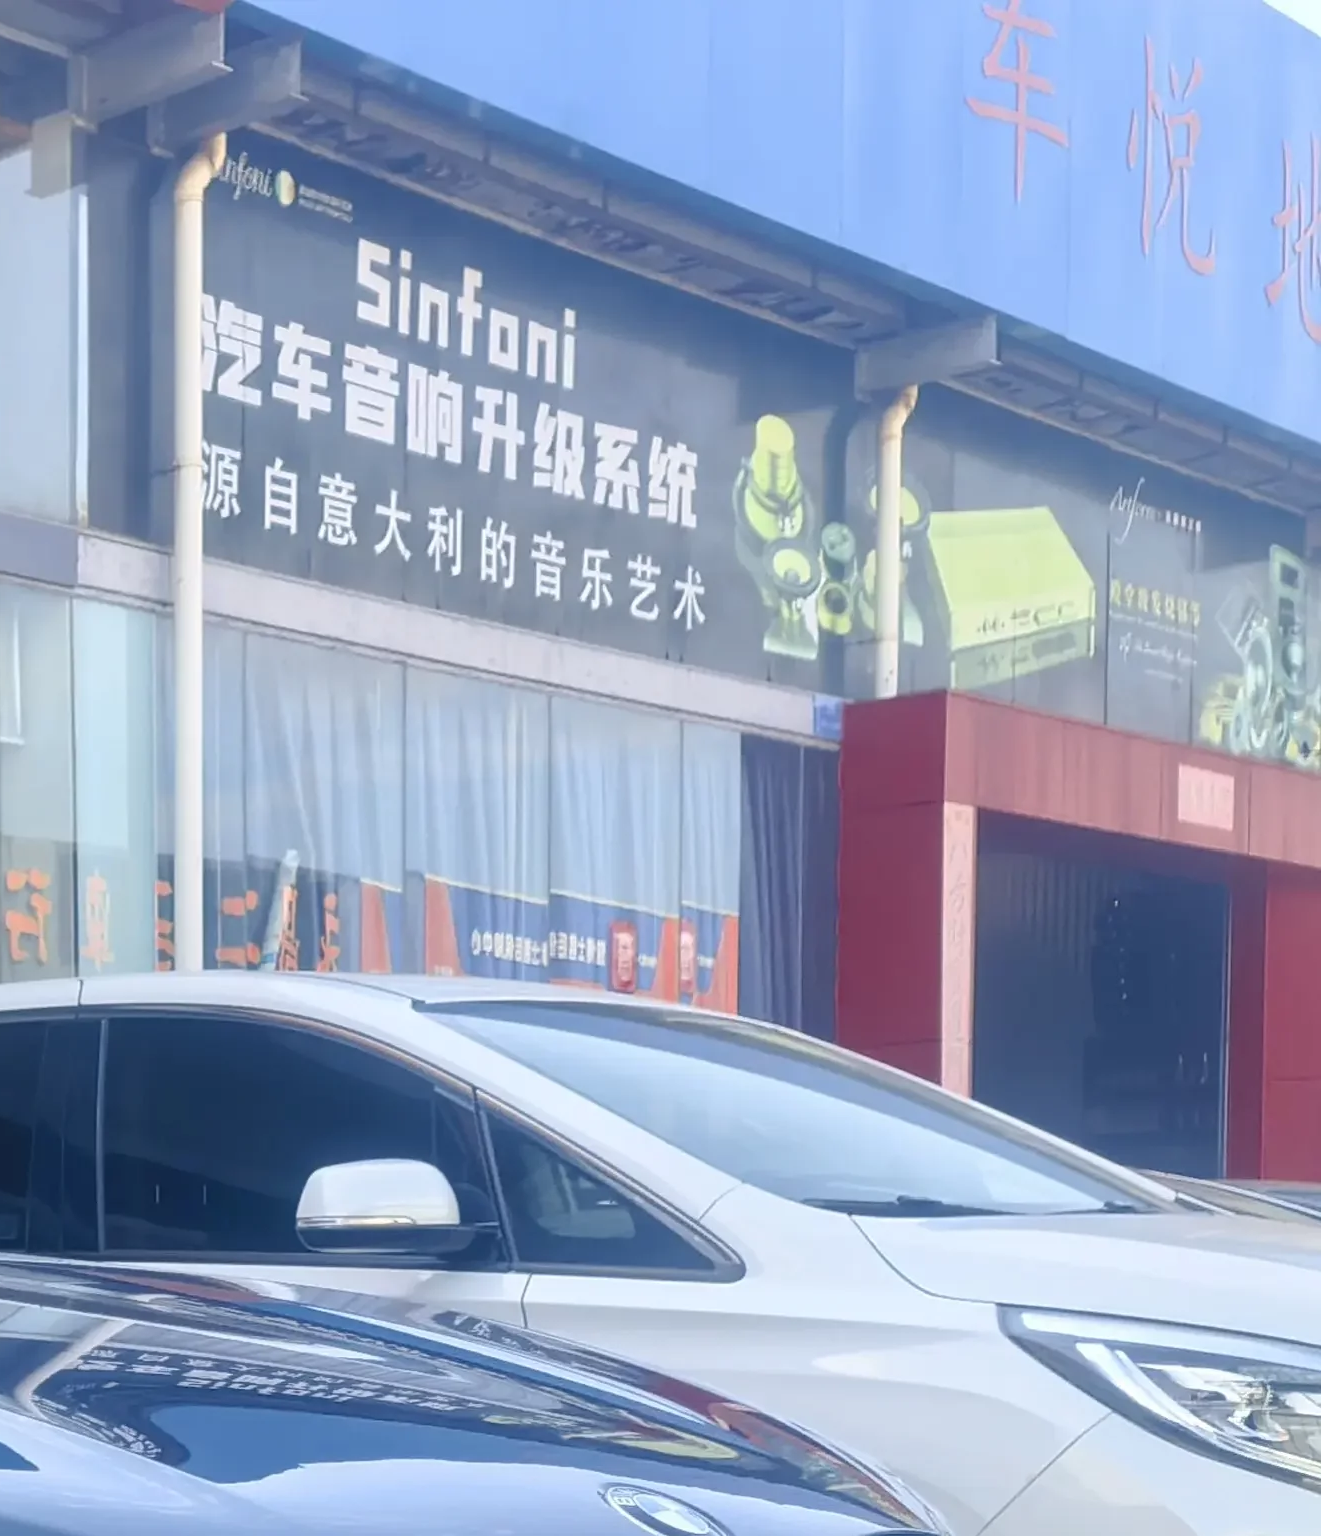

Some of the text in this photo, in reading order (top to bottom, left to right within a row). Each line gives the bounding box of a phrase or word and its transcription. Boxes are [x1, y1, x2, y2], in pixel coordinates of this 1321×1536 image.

[202, 292, 700, 529] 汽车音响升级系统
[356, 237, 578, 390] Sinfoni
[201, 437, 707, 632] 源自意大利的音乐艺术
